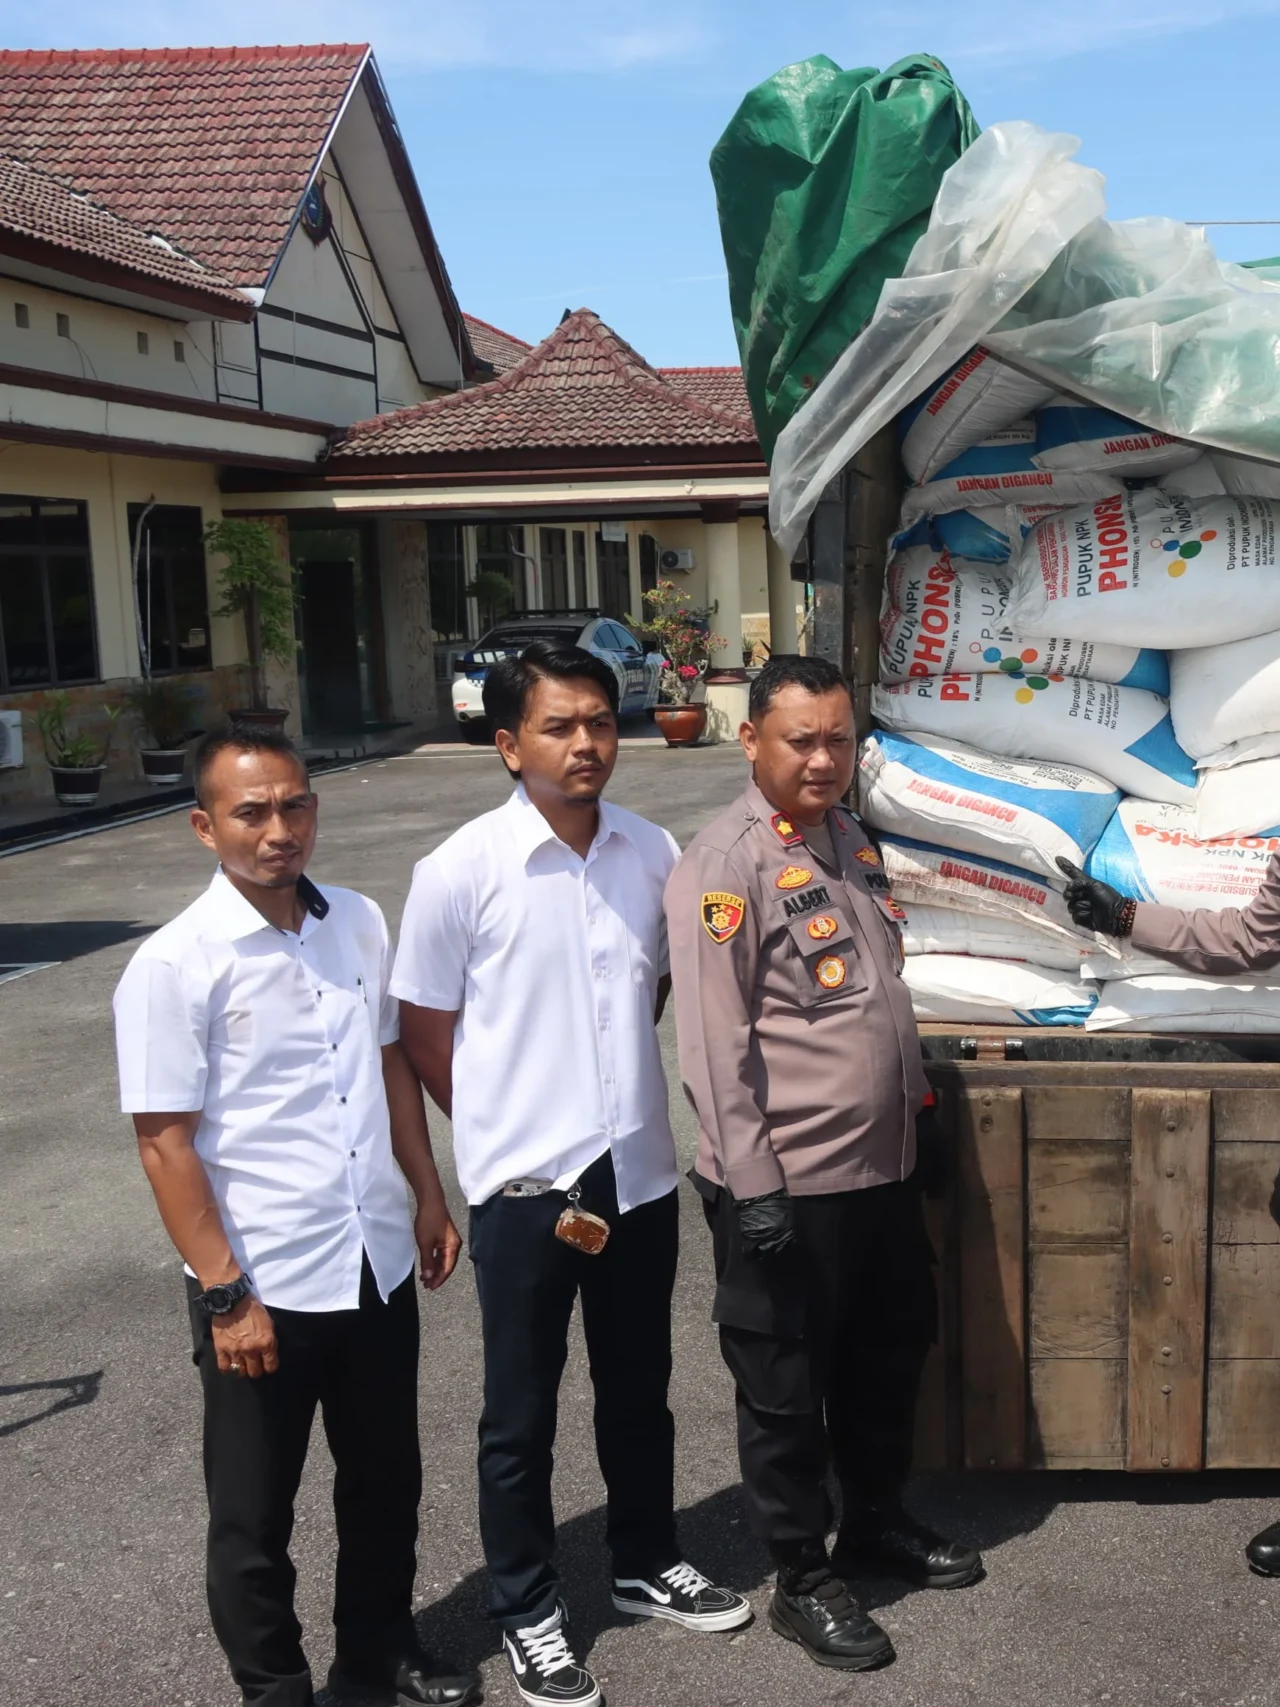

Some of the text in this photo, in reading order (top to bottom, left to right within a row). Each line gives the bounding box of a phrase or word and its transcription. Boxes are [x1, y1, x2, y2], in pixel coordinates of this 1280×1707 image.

[926, 379, 960, 416] JANGAN
[1103, 436, 1151, 455] JANGAN
[957, 473, 1053, 492] JANGAN DIGANCU
[1226, 528, 1237, 571] Diproduksi
[1241, 526, 1251, 554] PUPUK
[1074, 518, 1093, 598] PUPUK NPK
[1241, 556, 1250, 568] PT
[906, 579, 922, 614] NPK
[1047, 638, 1057, 652] ole
[1084, 707, 1094, 721] PT
[906, 779, 1019, 823] JANGAN DIGANCU
[1204, 848, 1245, 860] NPK
[939, 861, 1048, 906] JANGAN DIGANCU
[1219, 883, 1259, 896] SUBSIDI
[782, 885, 832, 918] ALBERT
